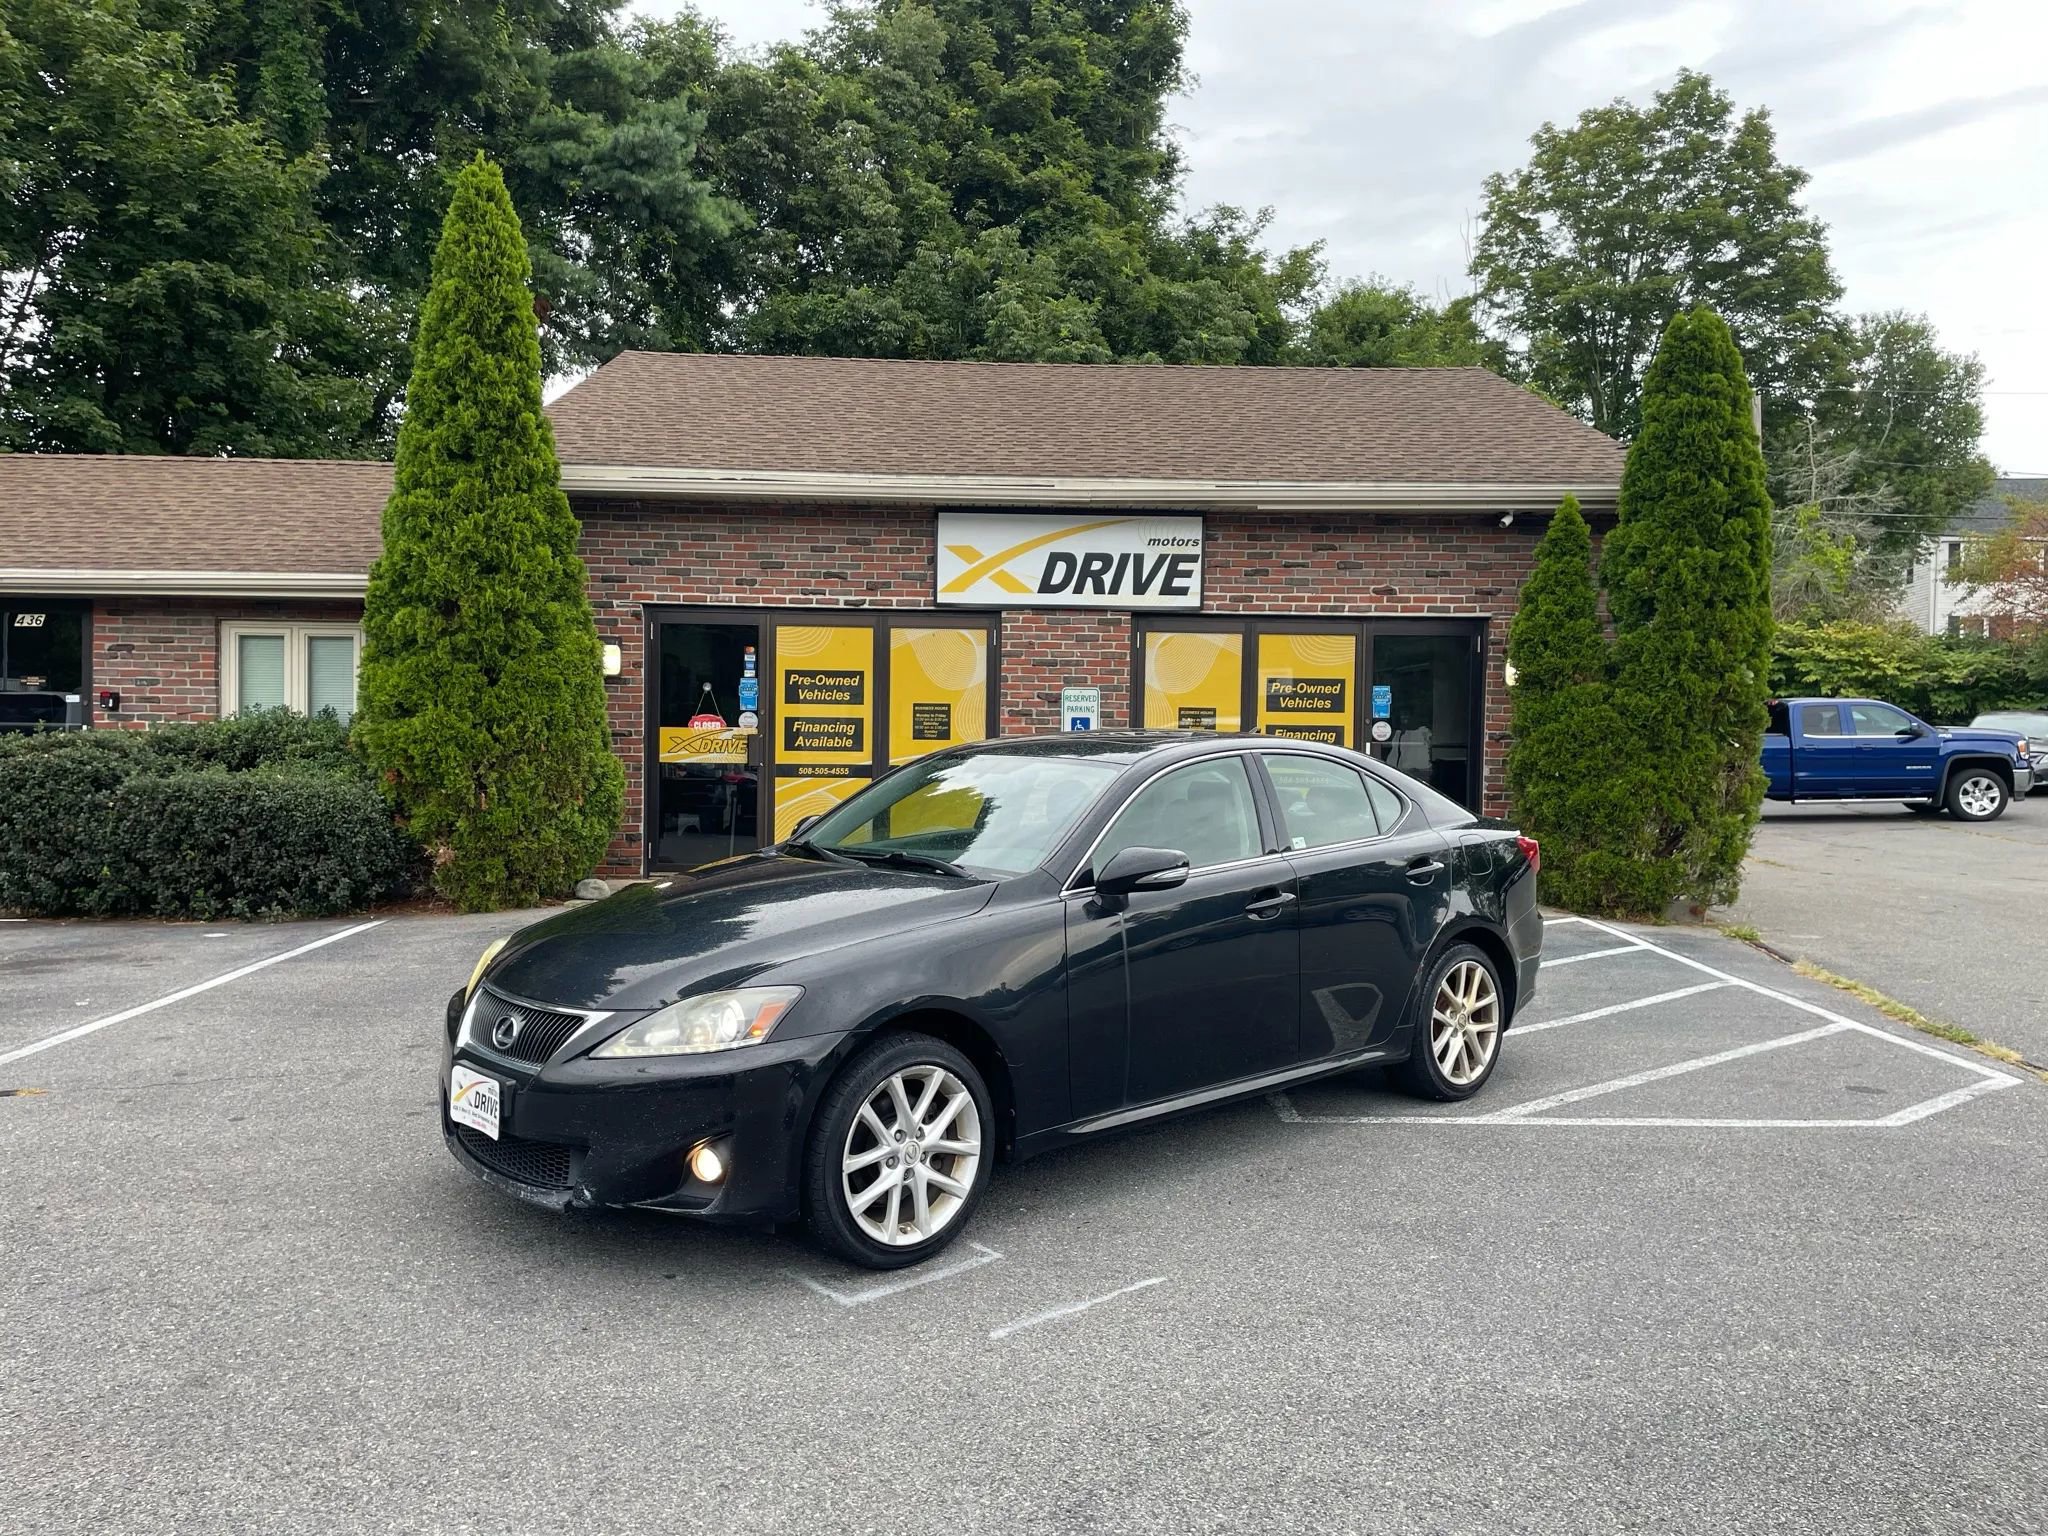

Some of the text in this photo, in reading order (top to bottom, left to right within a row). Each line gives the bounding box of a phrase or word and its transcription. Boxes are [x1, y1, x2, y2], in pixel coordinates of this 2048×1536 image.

[1147, 536, 1200, 548] motors
[16, 615, 43, 626] 436
[789, 674, 860, 687] Pre-Owned
[1271, 682, 1341, 695] Pre-Owned
[798, 689, 851, 701] Vehicles
[1064, 694, 1097, 703] RESERVED
[1279, 697, 1332, 709] Vehicles
[1066, 705, 1095, 714] PARKING
[693, 721, 721, 730] CLOSED
[793, 721, 856, 736] Financing
[794, 735, 853, 748] Available
[1275, 729, 1337, 744] Financing
[798, 767, 850, 775] 508-505-4555
